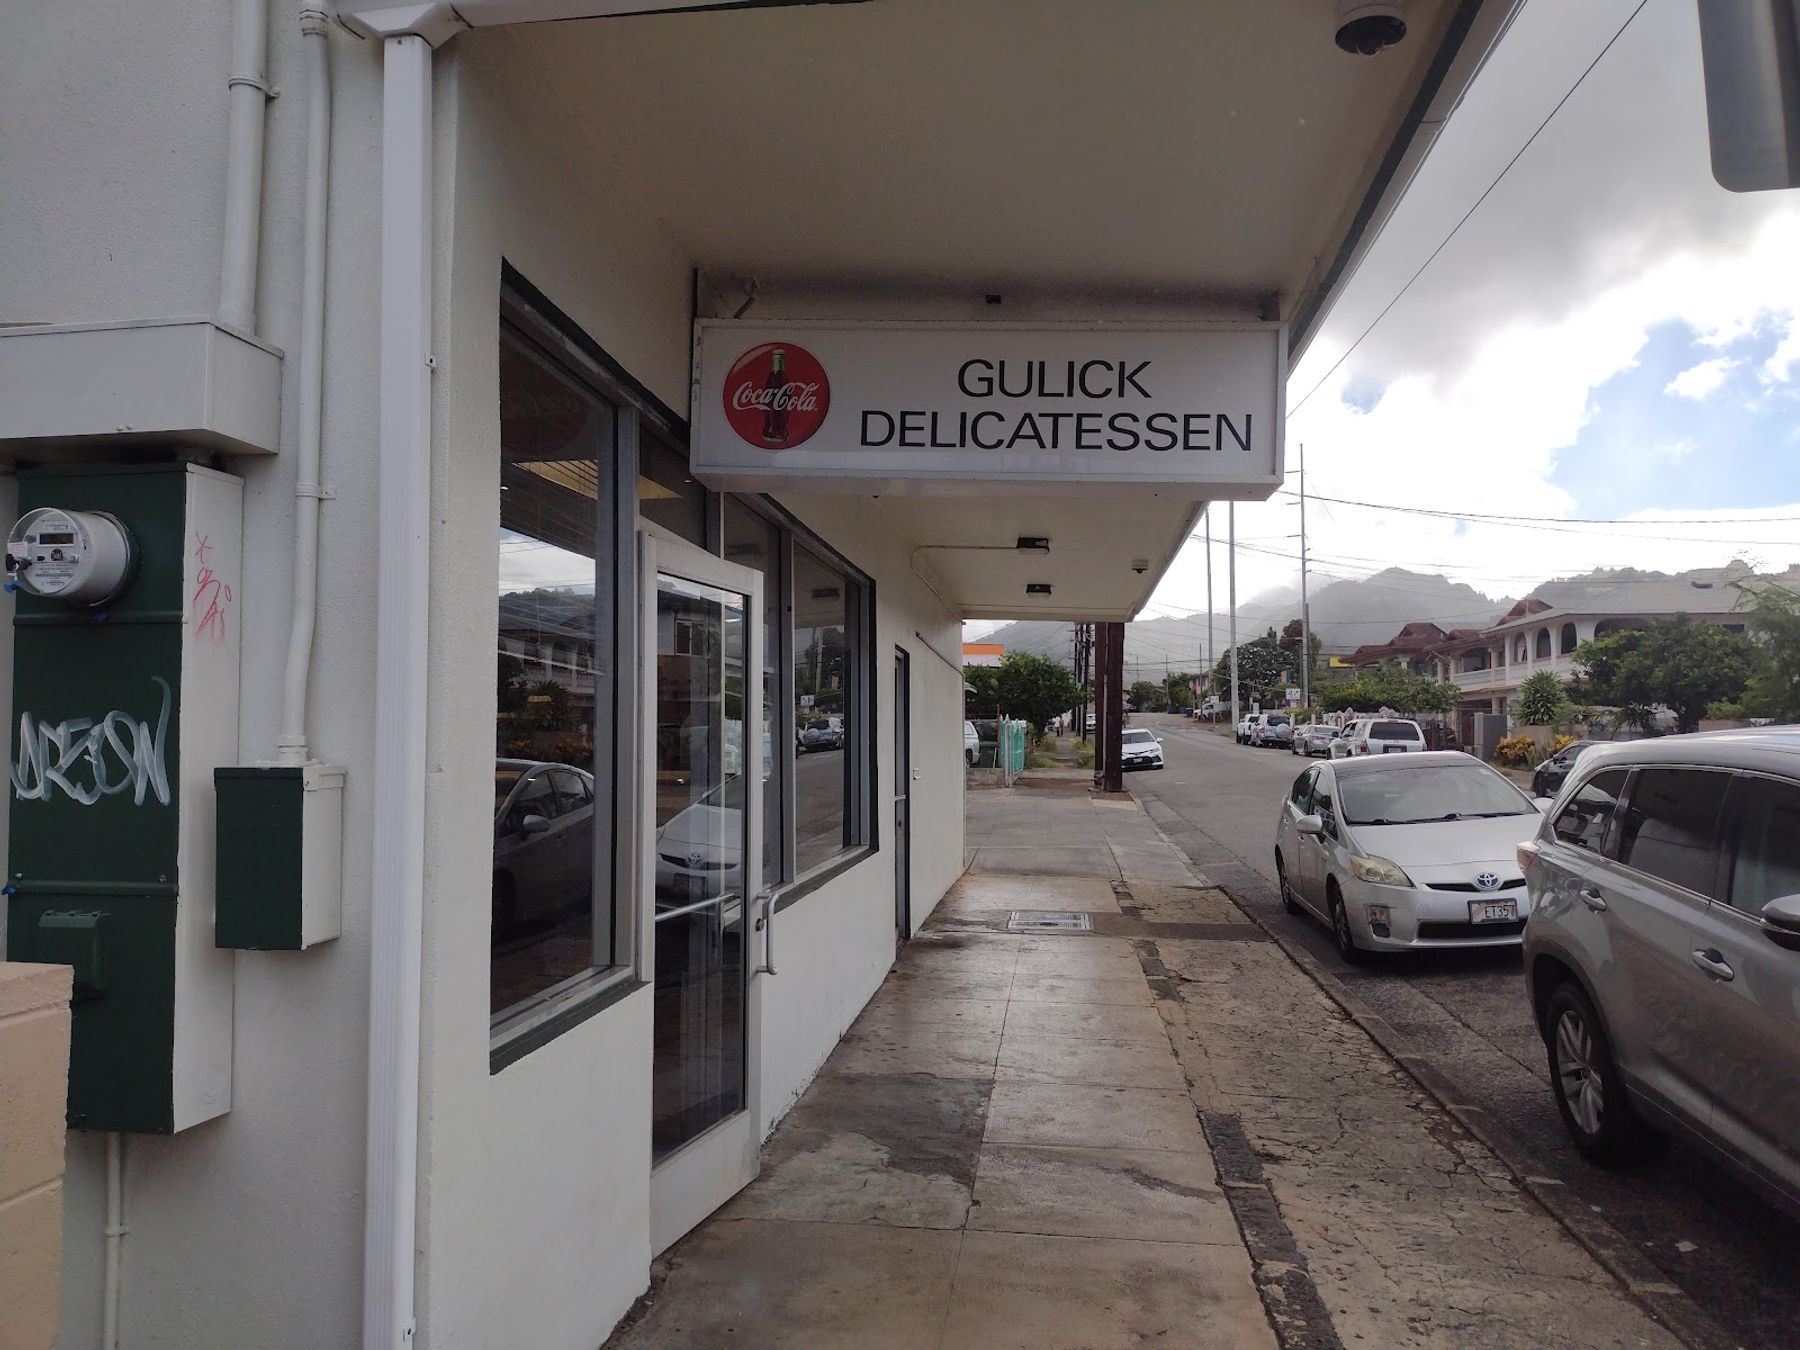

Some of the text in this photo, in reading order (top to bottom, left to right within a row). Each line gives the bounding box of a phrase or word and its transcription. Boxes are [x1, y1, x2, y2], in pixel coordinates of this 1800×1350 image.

[732, 381, 820, 412] Coca-Cola
[957, 358, 1152, 399] GULICK
[860, 410, 1252, 452] DELICATESSEN
